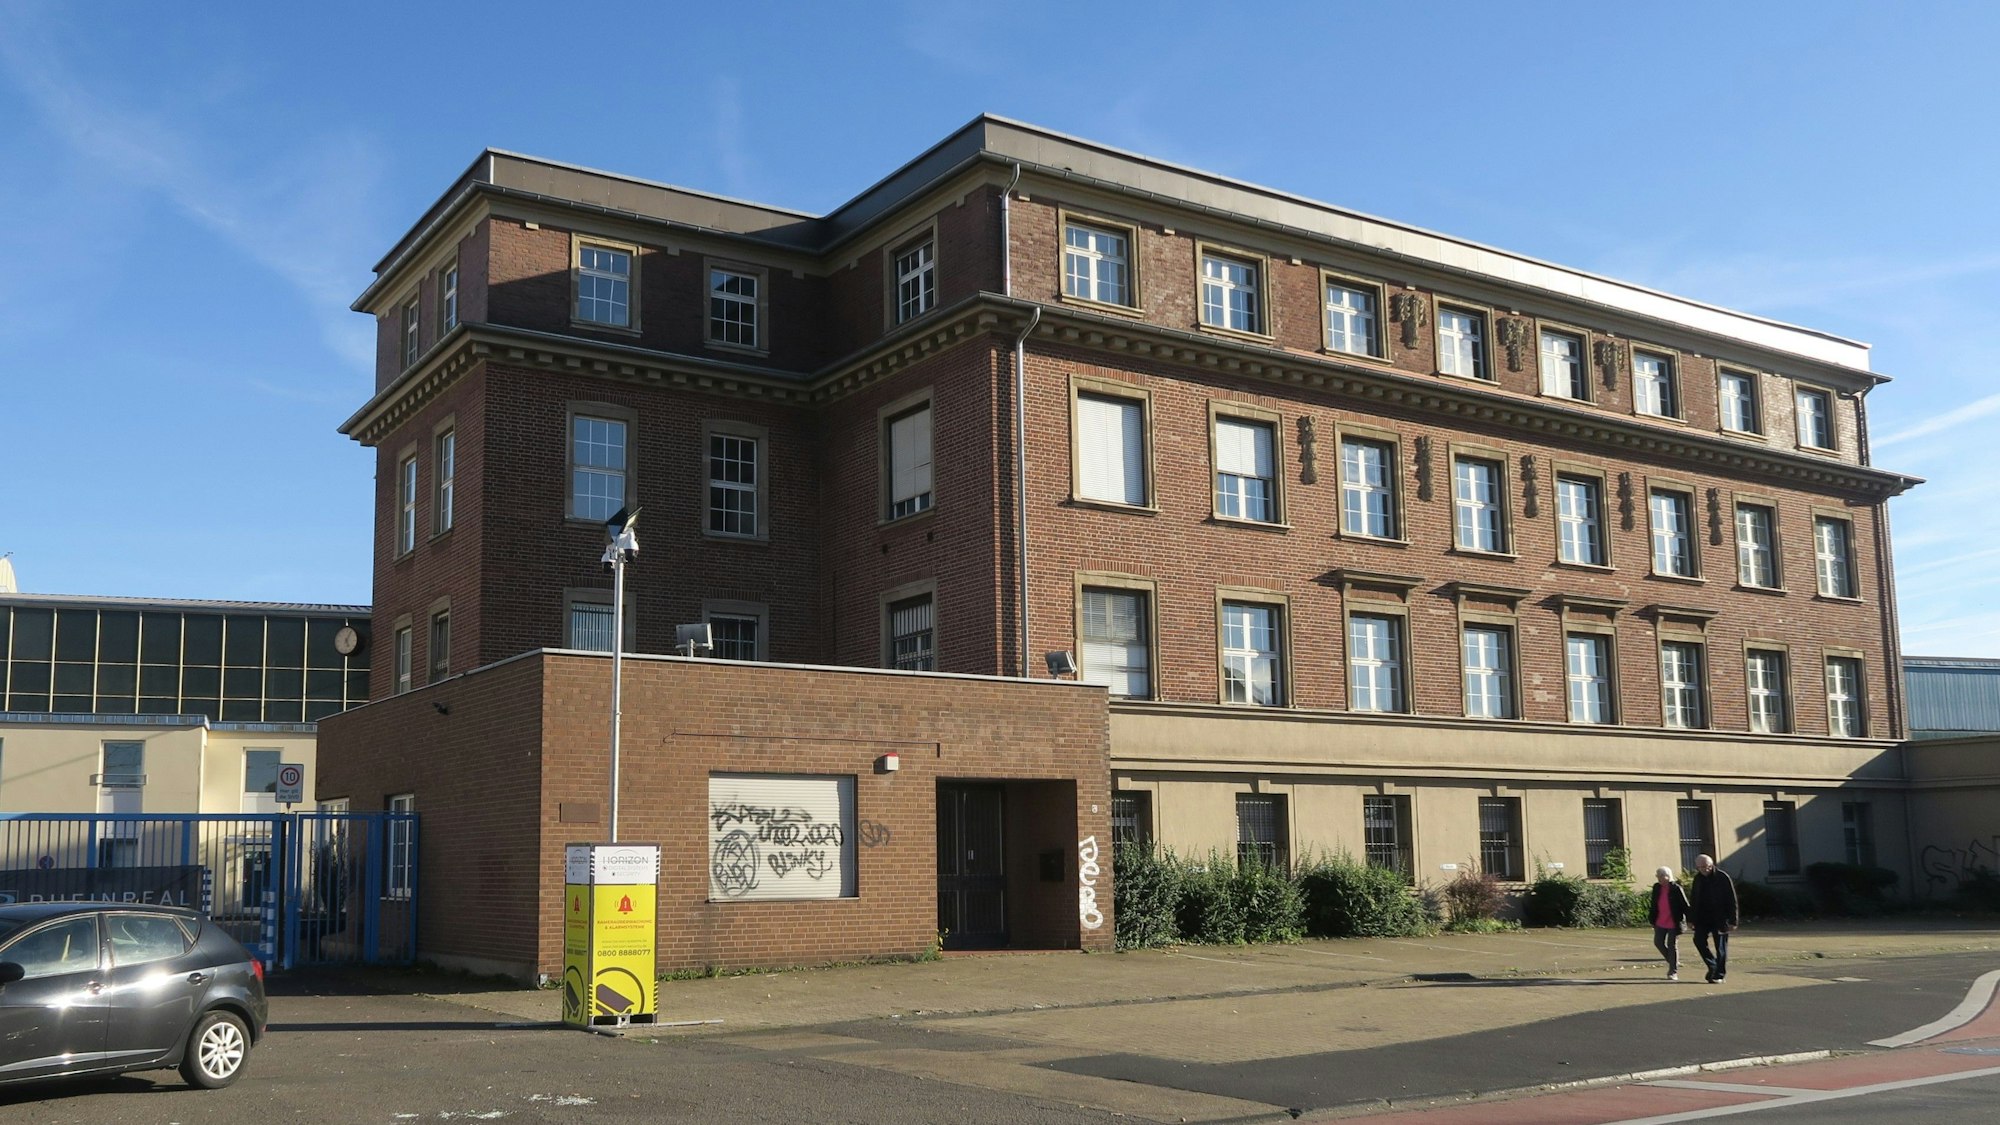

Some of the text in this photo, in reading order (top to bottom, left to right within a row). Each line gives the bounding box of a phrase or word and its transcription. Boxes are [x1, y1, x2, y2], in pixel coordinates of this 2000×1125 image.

[285, 772, 296, 781] 10
[602, 856, 649, 865] HORIZON
[597, 949, 617, 957] 0800
[618, 949, 651, 957] 8888077
